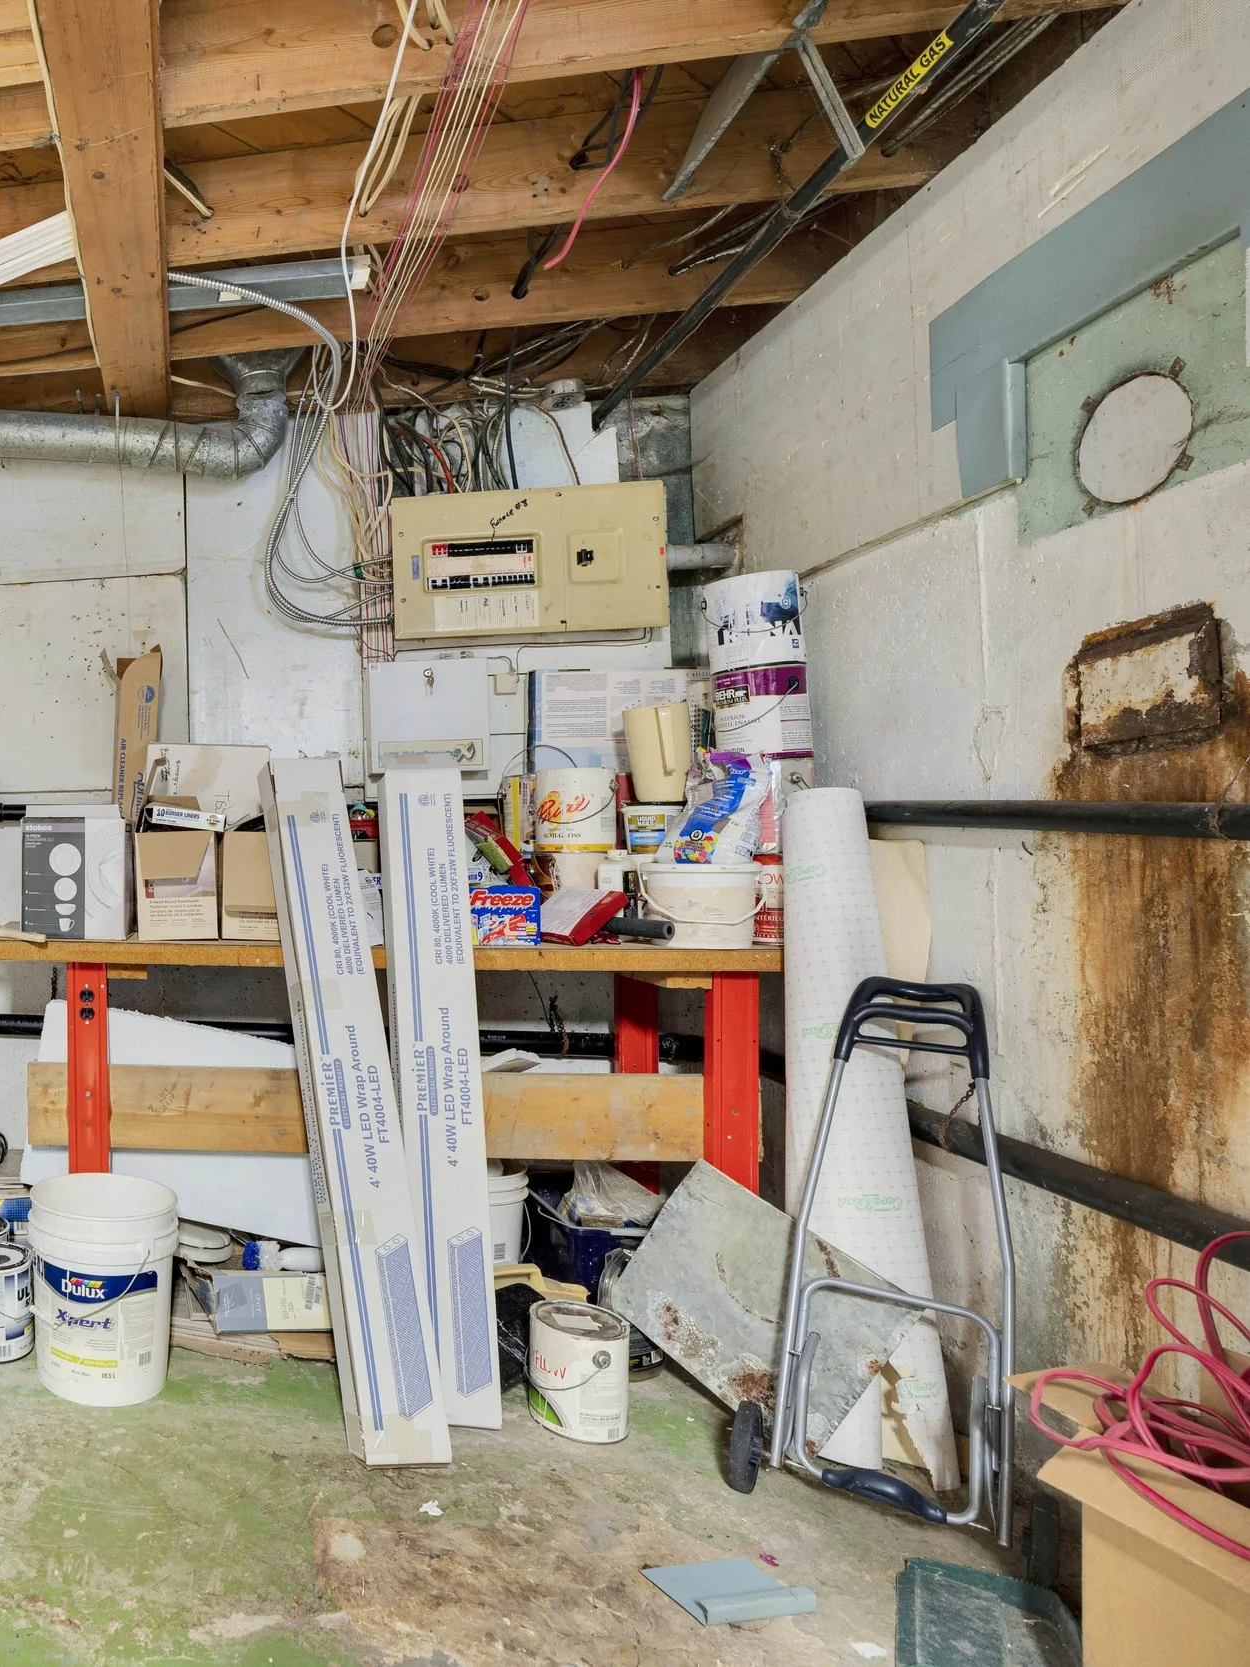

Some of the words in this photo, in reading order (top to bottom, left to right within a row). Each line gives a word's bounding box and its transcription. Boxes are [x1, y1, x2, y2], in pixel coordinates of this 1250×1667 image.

[869, 68, 920, 124] NATURAL
[919, 36, 947, 69] GAS
[715, 688, 735, 701] BEHR
[156, 808, 166, 817] 10
[444, 794, 456, 857] FLUORESCENT)
[332, 814, 348, 872] FLUORESCENT)
[322, 863, 332, 892] WHITE)
[427, 848, 436, 878] WHITE)
[449, 860, 458, 892] 2XF32W
[332, 878, 344, 906] LUMEN
[342, 874, 353, 905] 2XF32W
[430, 880, 440, 906] (COOL
[438, 864, 448, 894] LUMEN
[326, 894, 337, 919] (COOL
[348, 907, 355, 918] TO
[452, 894, 459, 906] TO
[470, 890, 534, 906] Freeze
[330, 920, 339, 945] 4000K
[338, 908, 351, 954] DELIVERED
[432, 908, 440, 934] 4000K
[441, 894, 452, 942] DELIVERED
[349, 920, 366, 975] (EQUIVALENT
[452, 908, 466, 964] (EQUIVALENT
[344, 956, 354, 975] 4000
[438, 1007, 453, 1054] Around
[345, 1025, 364, 1072] Around
[428, 1047, 436, 1080] PRODUCTS
[334, 1060, 346, 1091] PRODUCTS
[442, 1057, 455, 1092] Wrap
[458, 1048, 472, 1125] FT4004-LED
[354, 1075, 368, 1110] Wrap
[367, 1065, 390, 1144] FT4004-LED
[430, 1080, 438, 1114] ELECTRICAL
[444, 1094, 456, 1120] LED
[339, 1092, 350, 1127] ELECTRICAL
[360, 1112, 373, 1140] LED
[446, 1124, 458, 1152] 40W
[364, 1144, 378, 1174] 40W
[61, 1278, 106, 1299] Dulux
